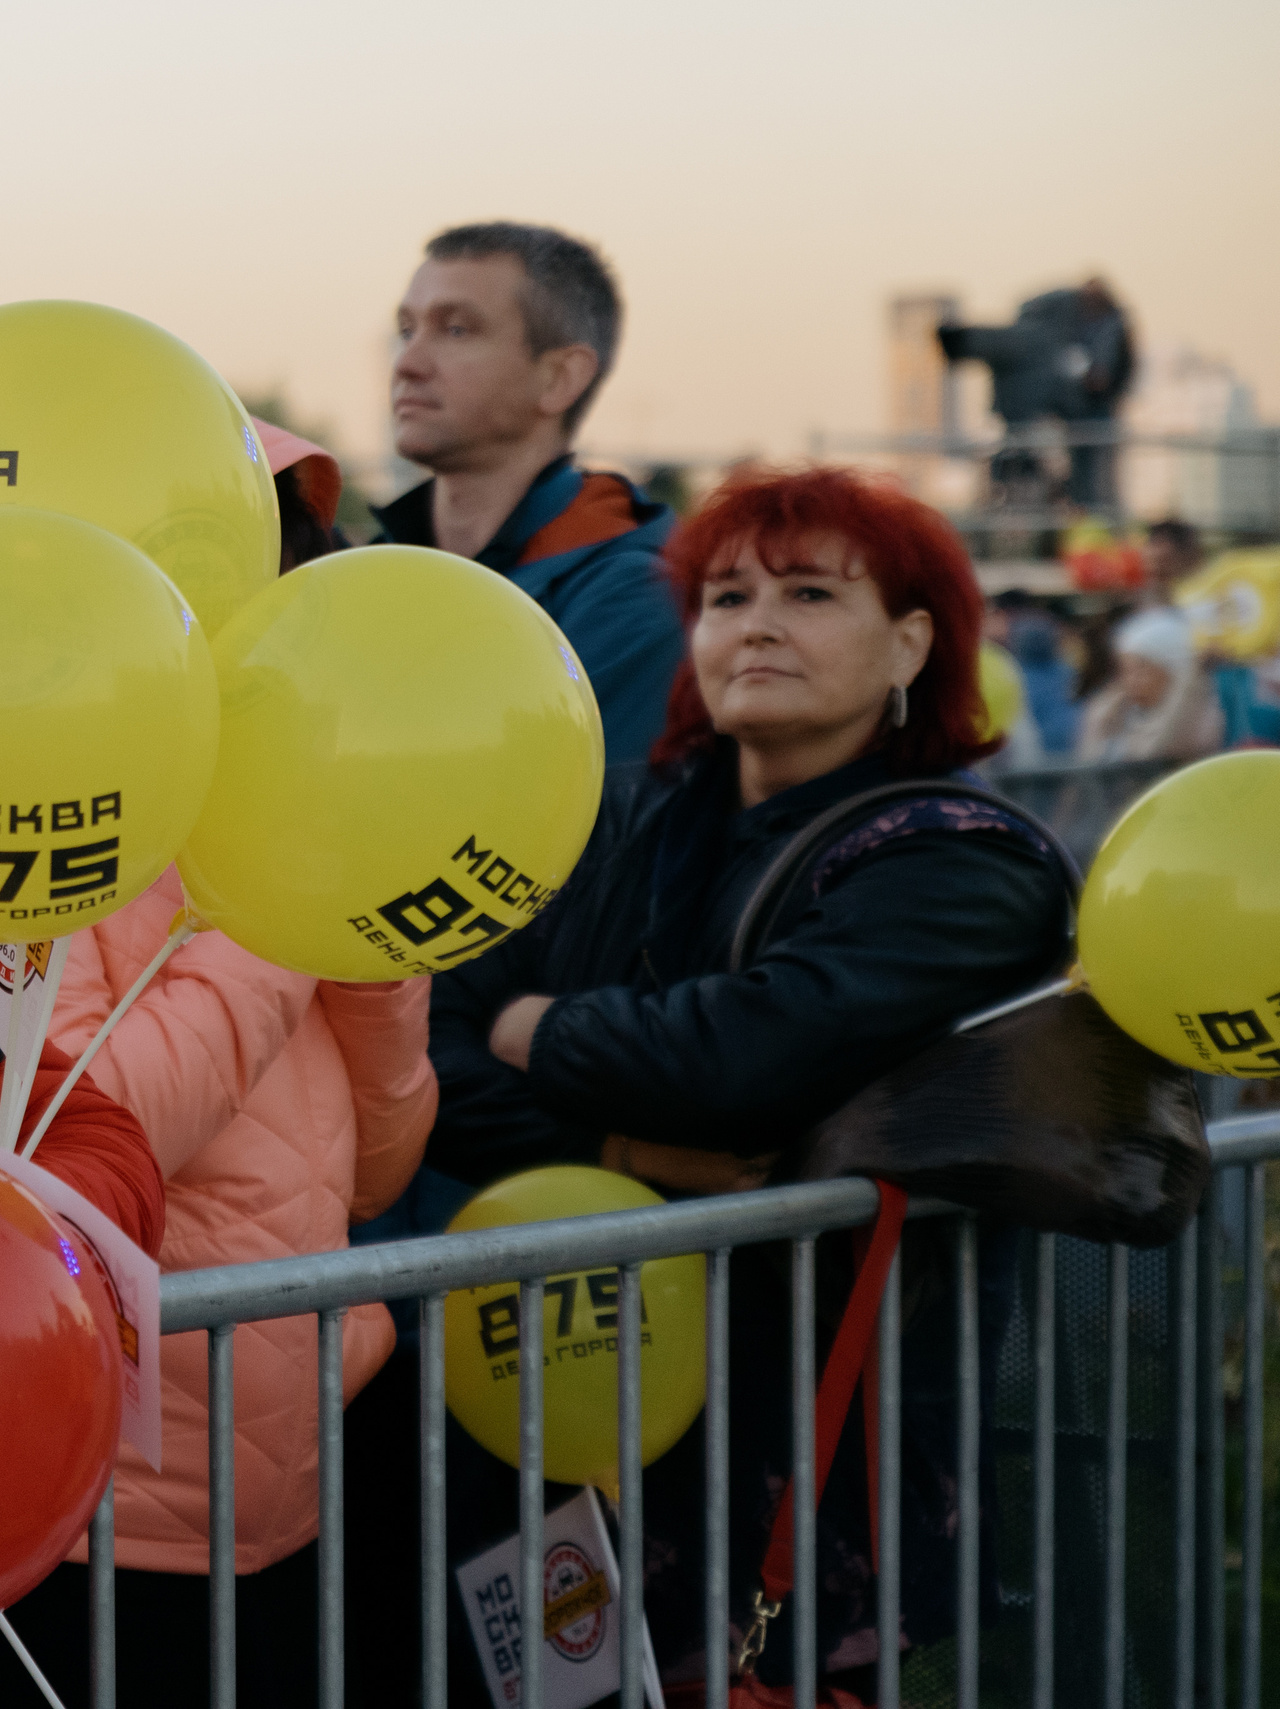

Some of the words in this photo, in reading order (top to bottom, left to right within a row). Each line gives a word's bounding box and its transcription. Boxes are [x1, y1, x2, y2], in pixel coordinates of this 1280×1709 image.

[451, 835, 559, 915] МОСКВ
[346, 915, 407, 963] ДЕНЬ
[376, 876, 517, 963] 87
[477, 1271, 649, 1359] 875
[555, 1330, 653, 1363] ГОРОА
